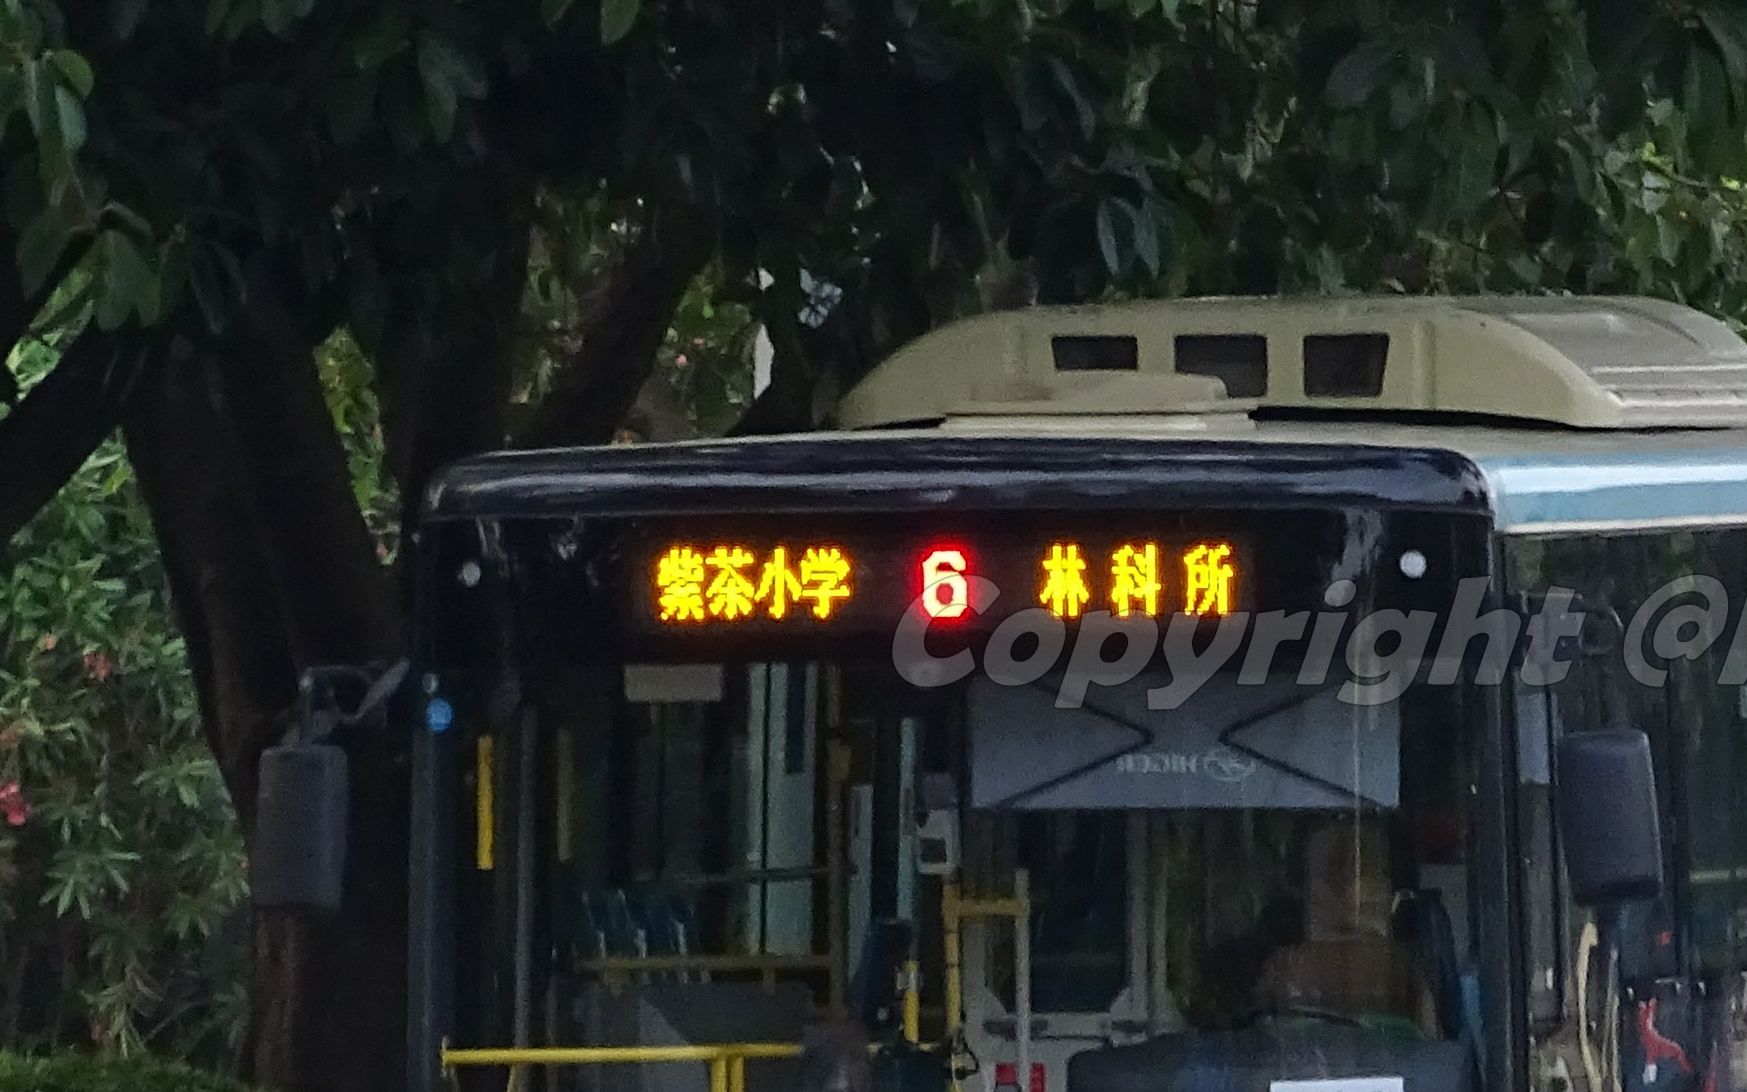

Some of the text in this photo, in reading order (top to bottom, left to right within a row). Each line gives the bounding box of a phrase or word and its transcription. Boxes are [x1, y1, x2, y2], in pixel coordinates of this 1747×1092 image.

[658, 544, 1234, 620] 紫茶小学 6 林科所
